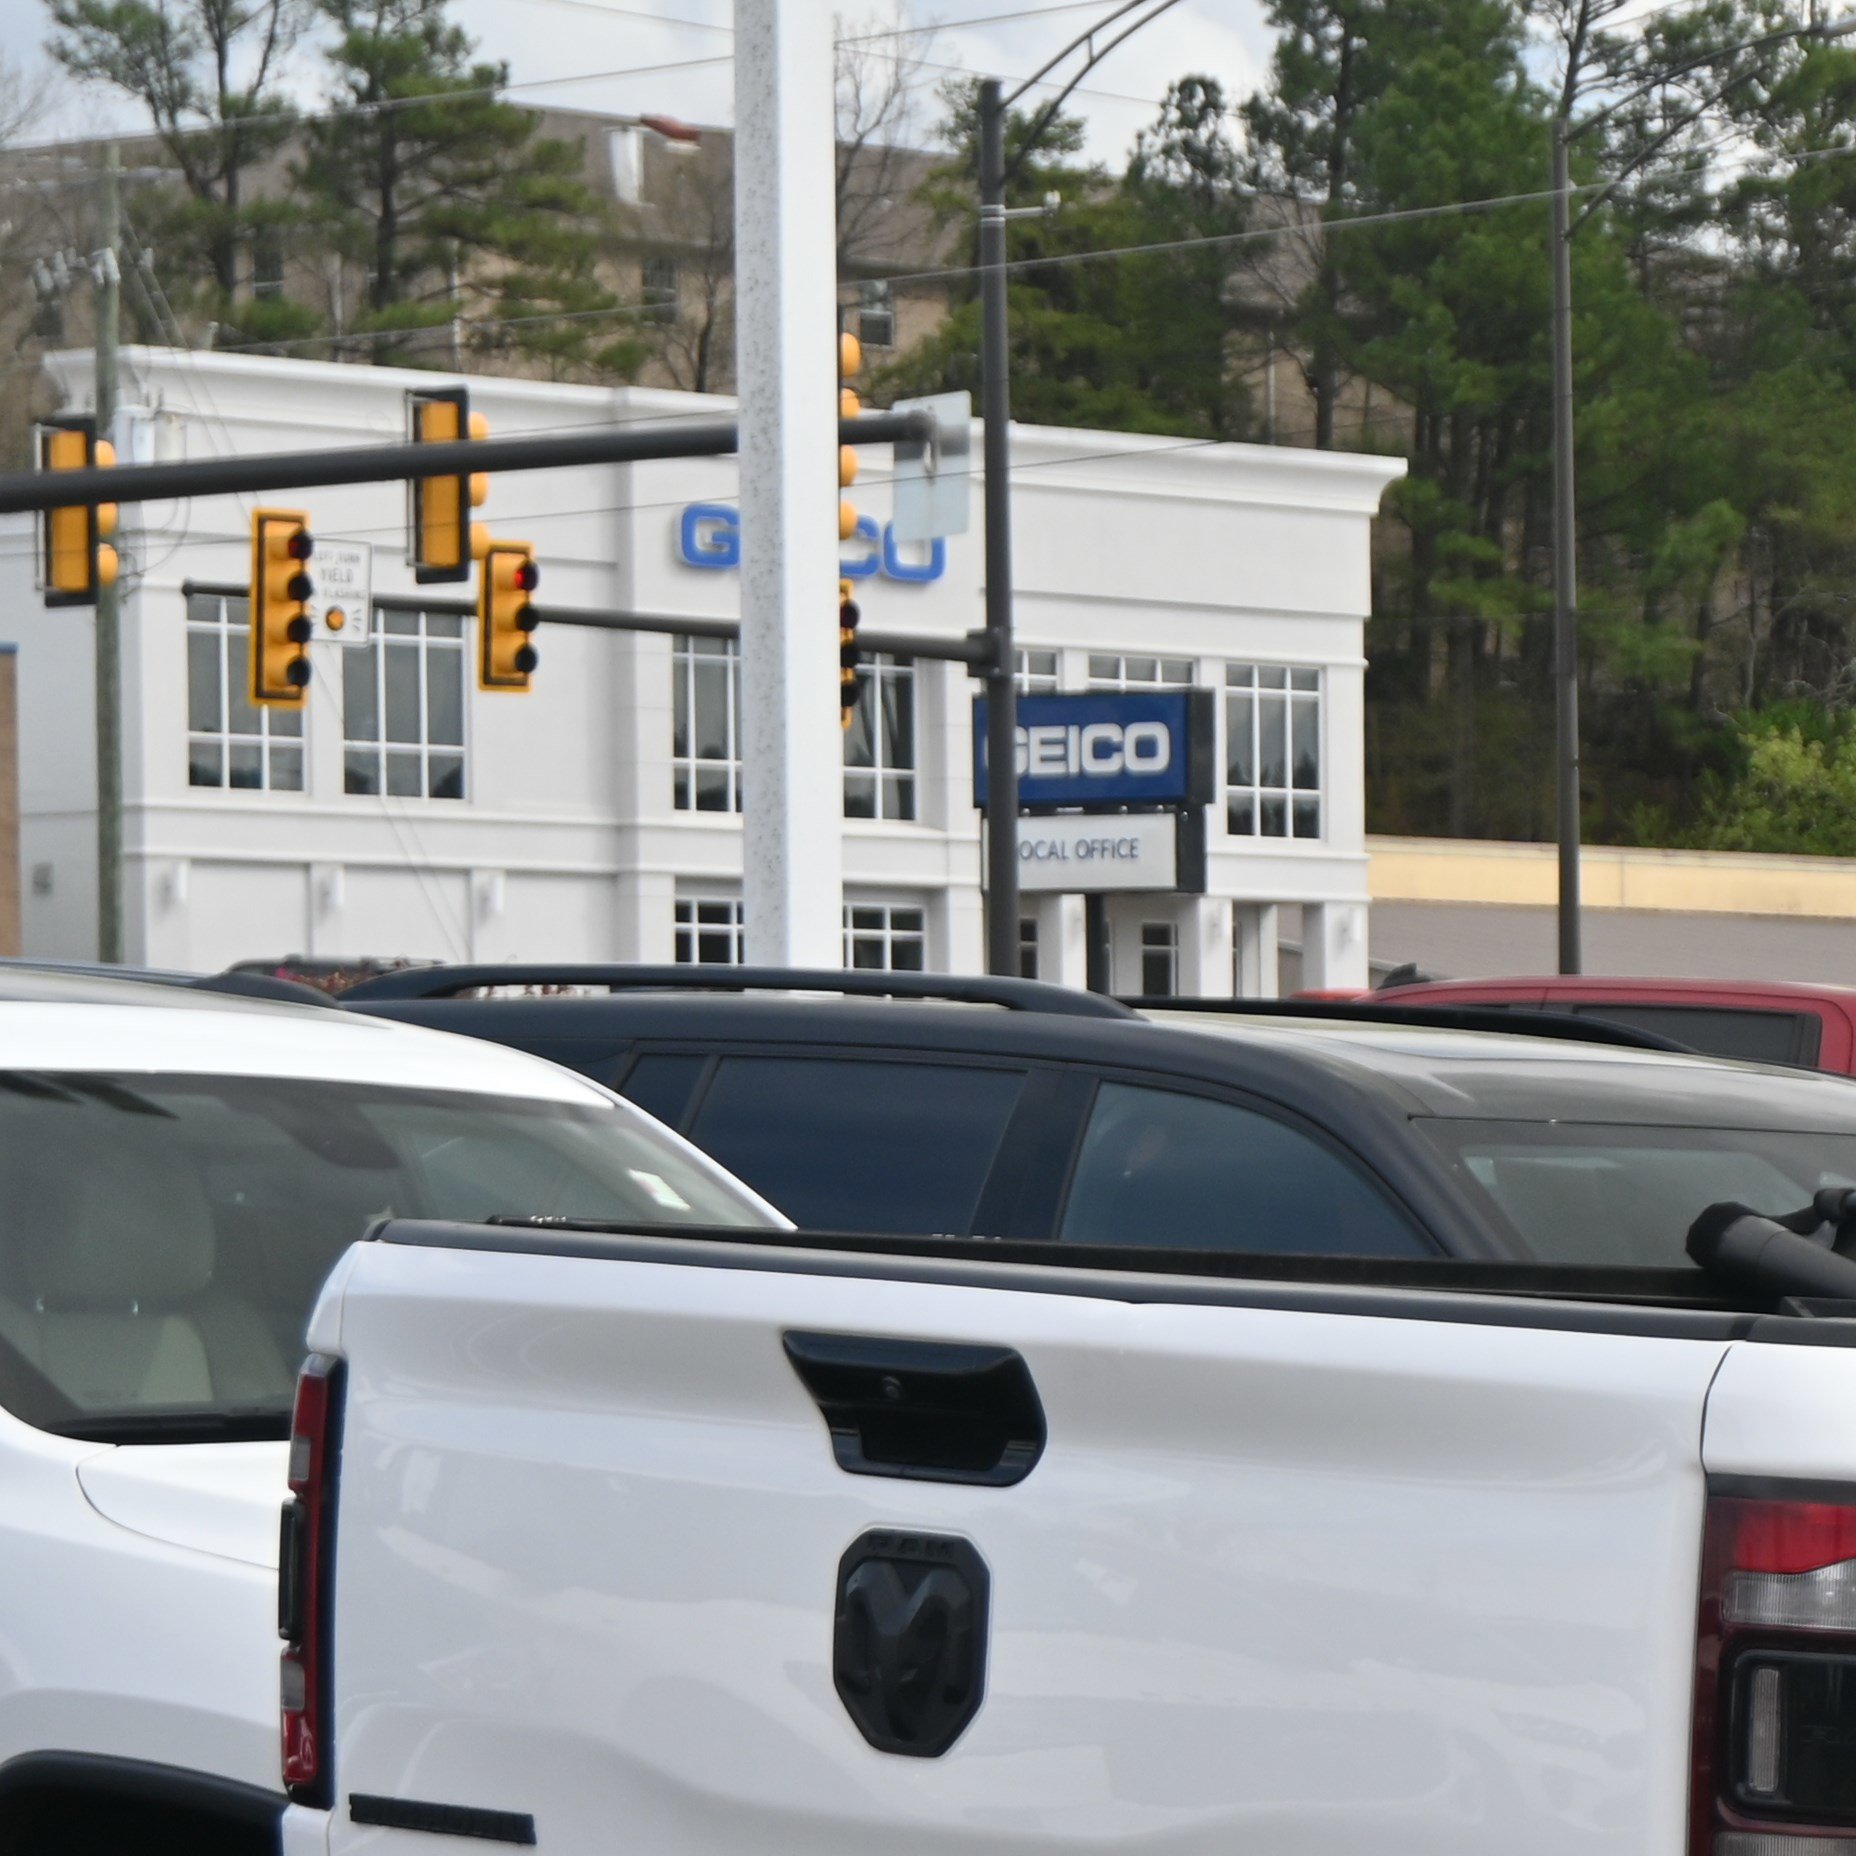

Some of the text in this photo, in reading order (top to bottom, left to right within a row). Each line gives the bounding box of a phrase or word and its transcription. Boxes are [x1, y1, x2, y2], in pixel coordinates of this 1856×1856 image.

[681, 503, 946, 582] GCO
[320, 568, 354, 583] YIELD
[1017, 838, 1140, 861] OCAL OFFICE
